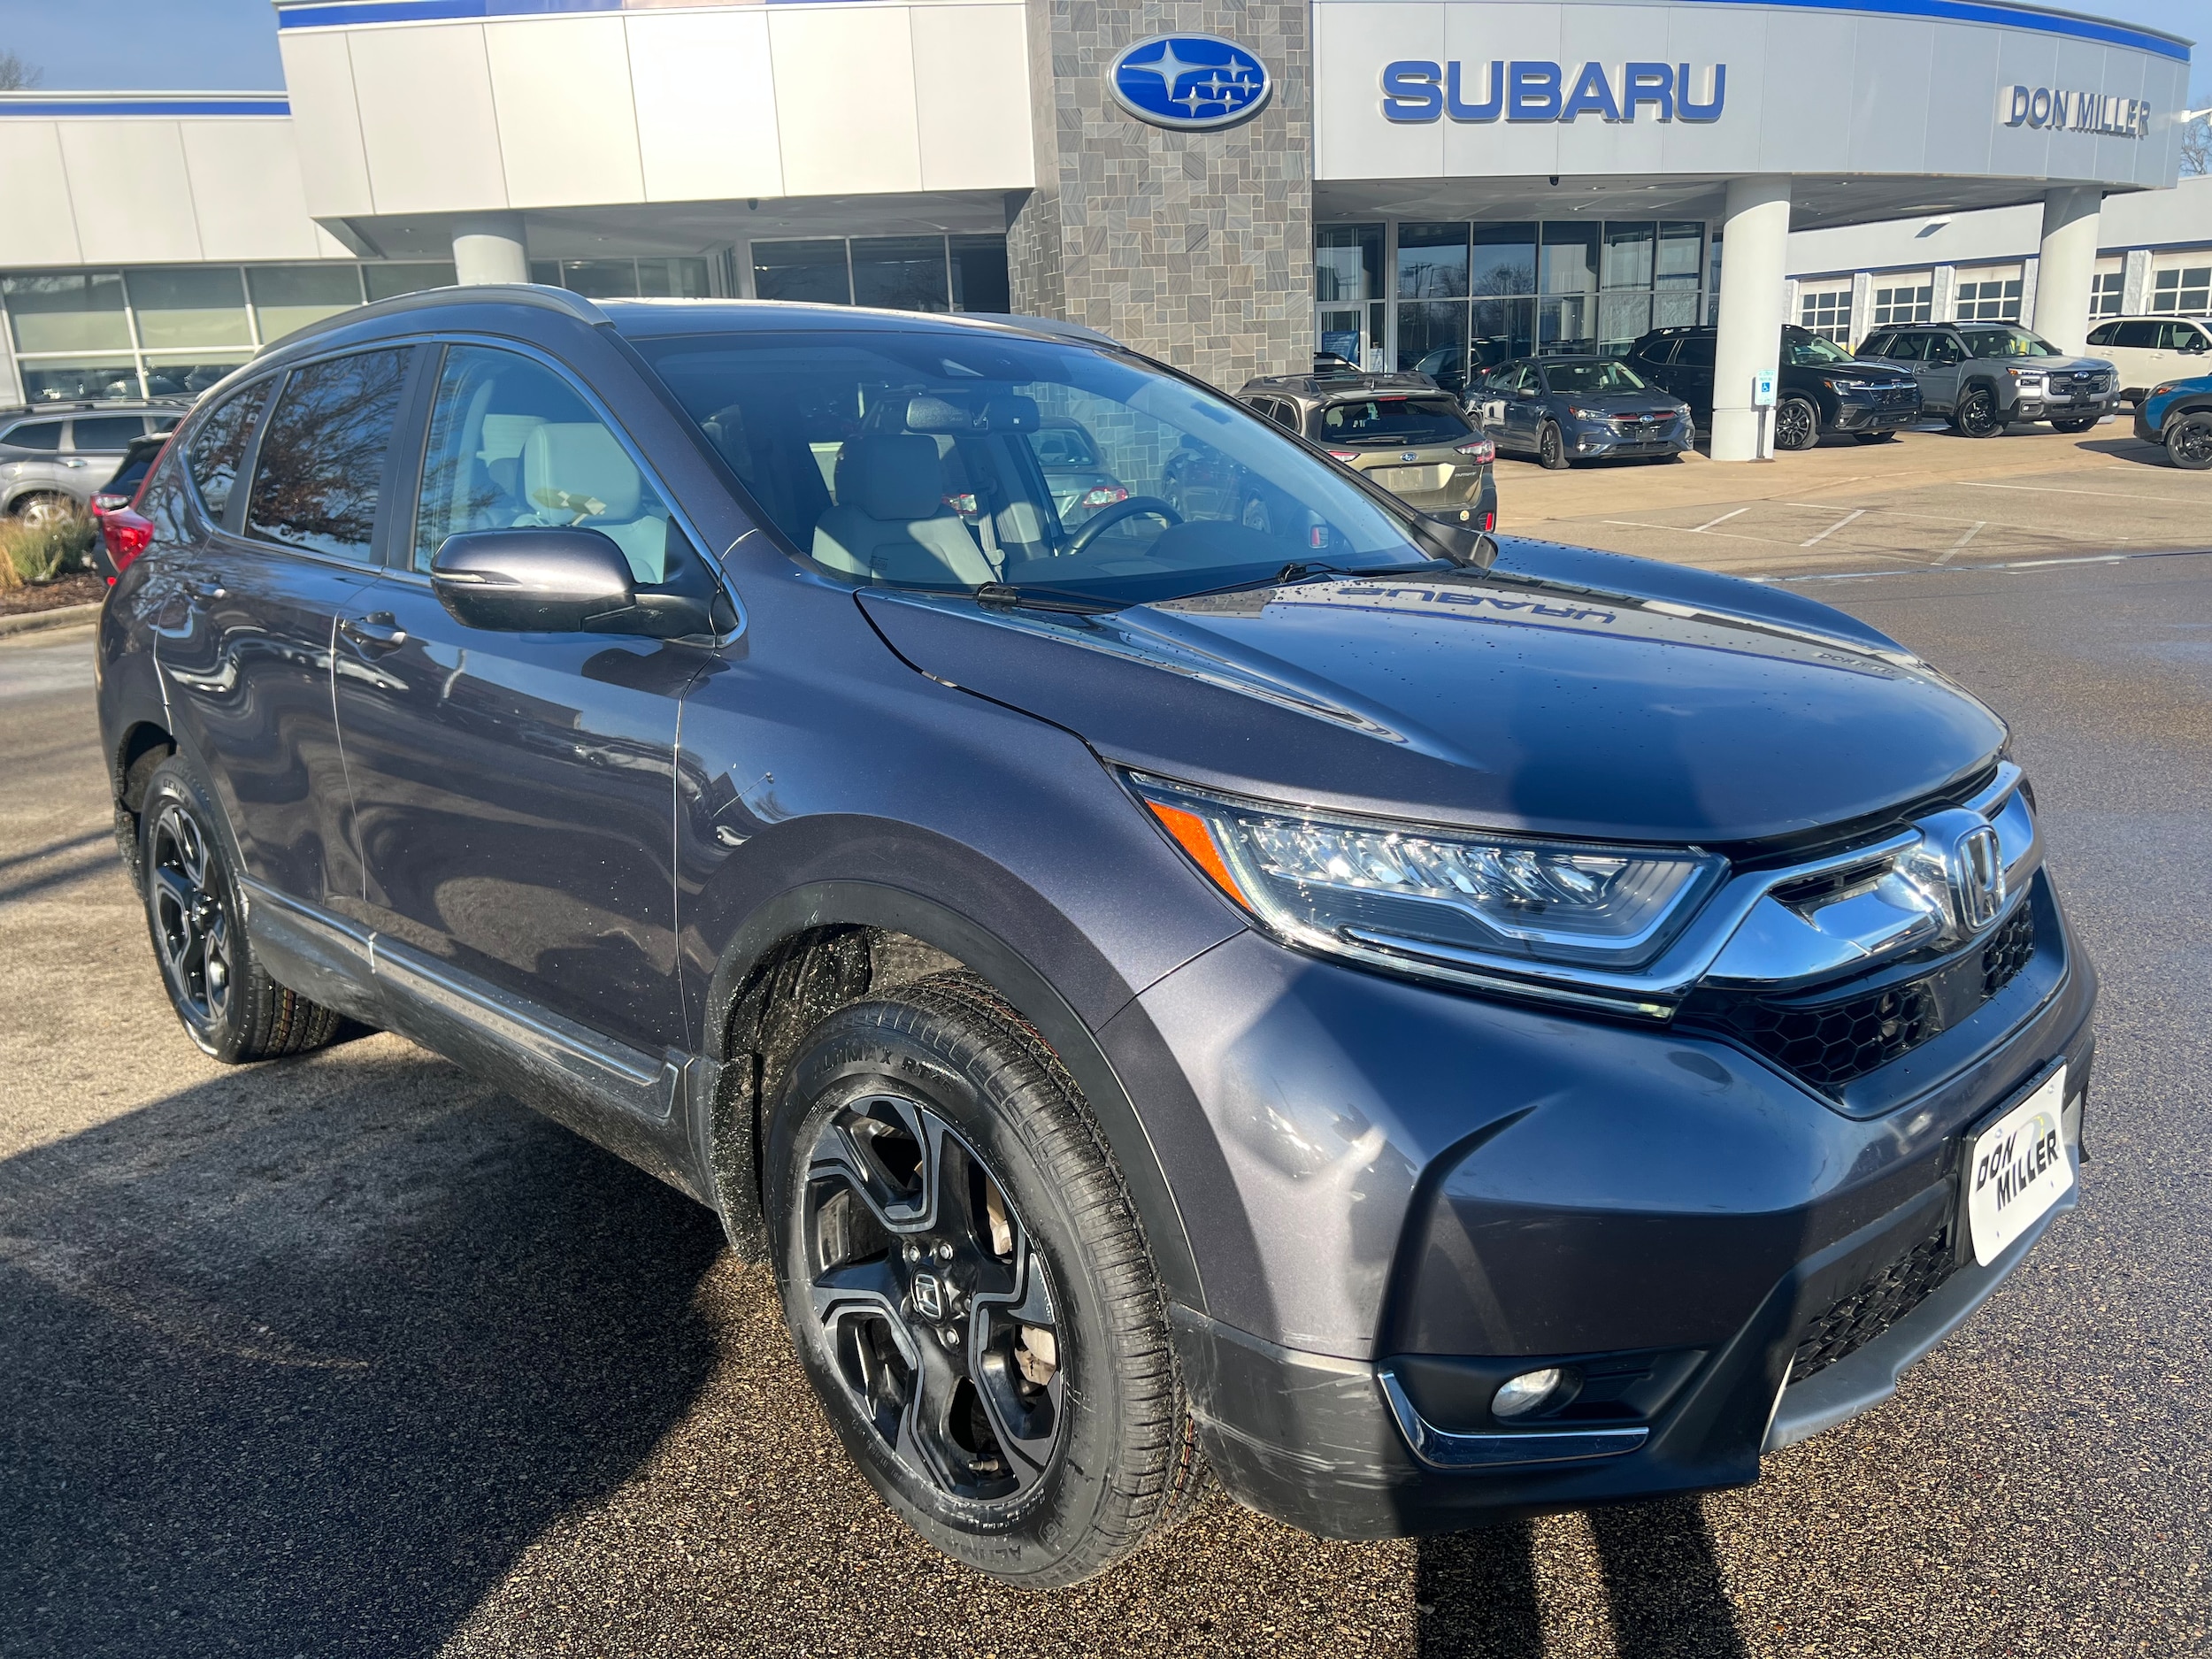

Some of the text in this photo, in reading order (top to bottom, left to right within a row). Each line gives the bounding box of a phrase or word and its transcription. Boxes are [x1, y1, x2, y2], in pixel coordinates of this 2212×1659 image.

[1382, 59, 1726, 123] SUBARU
[2006, 85, 2151, 139] DON MILLER
[1976, 1130, 2017, 1192] DON
[1997, 1129, 2059, 1211] MILLER
